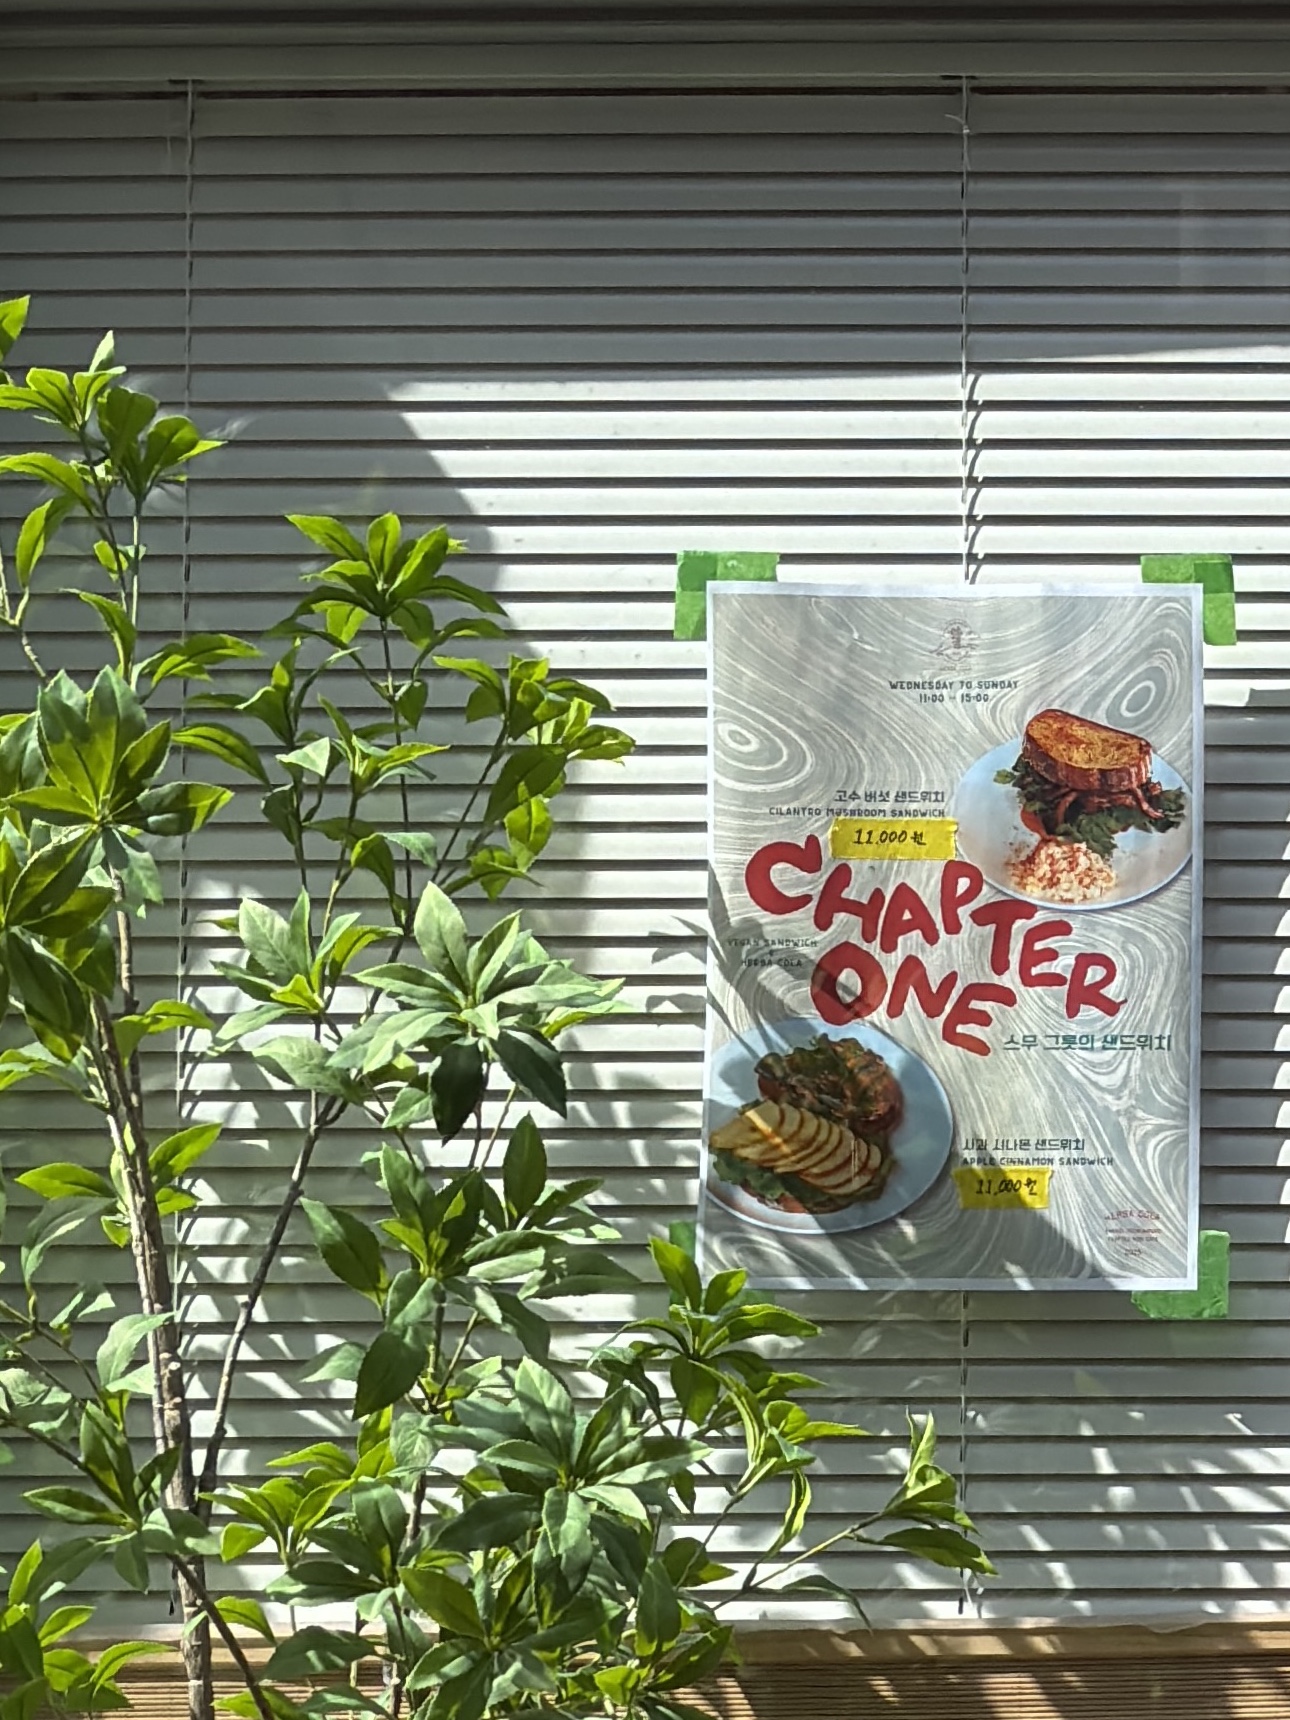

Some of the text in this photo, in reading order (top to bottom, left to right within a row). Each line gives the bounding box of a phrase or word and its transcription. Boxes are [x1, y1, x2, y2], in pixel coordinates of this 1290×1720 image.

[889, 680, 1019, 690] WEDNESDAY TO SUNDAY
[834, 790, 945, 803] 고수 버섯 샌드위치
[769, 807, 945, 817] CILANTRO MUSHROOM SANDWICH
[745, 835, 1127, 1018] CHAPTER
[811, 942, 1018, 1057] ONE
[1003, 1034, 1038, 1051] 스무
[1101, 1034, 1172, 1051] 샌드위치
[963, 1139, 1085, 1151] 사과 시나몬 샌드위치
[962, 1157, 1114, 1166] APPLE CINNAMON SANDWICH
